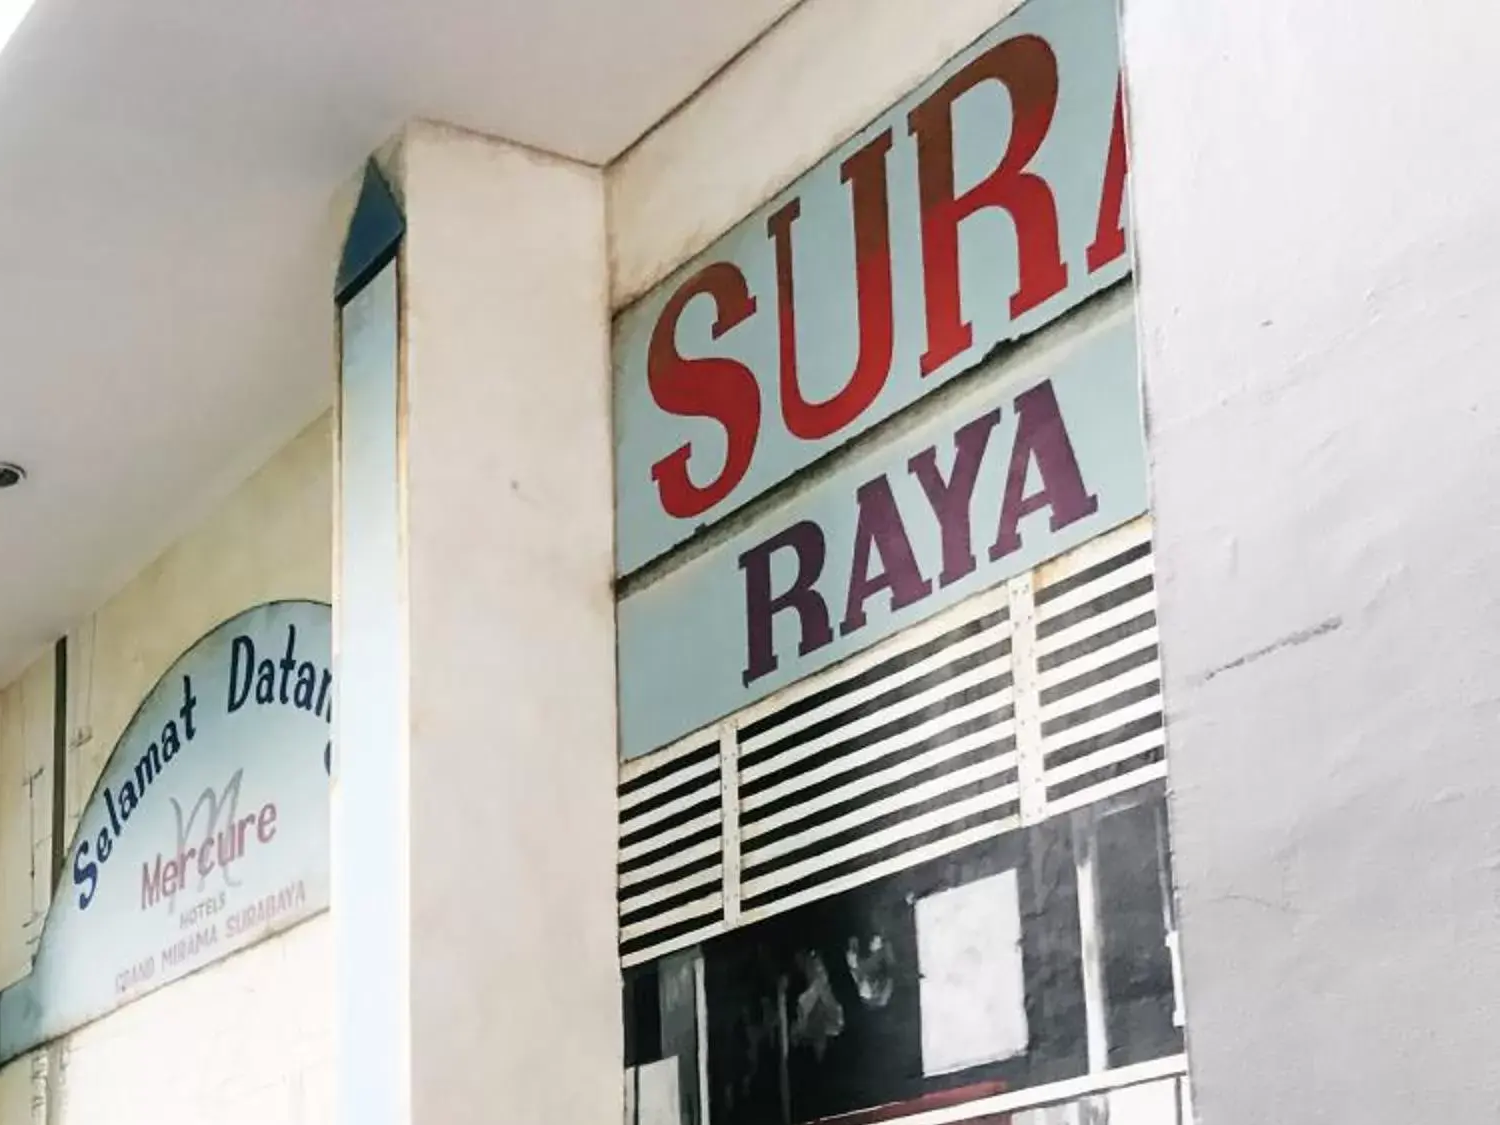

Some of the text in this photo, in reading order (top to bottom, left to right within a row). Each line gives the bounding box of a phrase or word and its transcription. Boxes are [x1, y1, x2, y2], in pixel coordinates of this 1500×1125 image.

[738, 378, 1098, 687] RAYA
[73, 674, 197, 910] Selamat
[141, 802, 277, 909] Mercure
[161, 924, 218, 970] MIRAMA
[225, 880, 306, 937] SURABAYA
